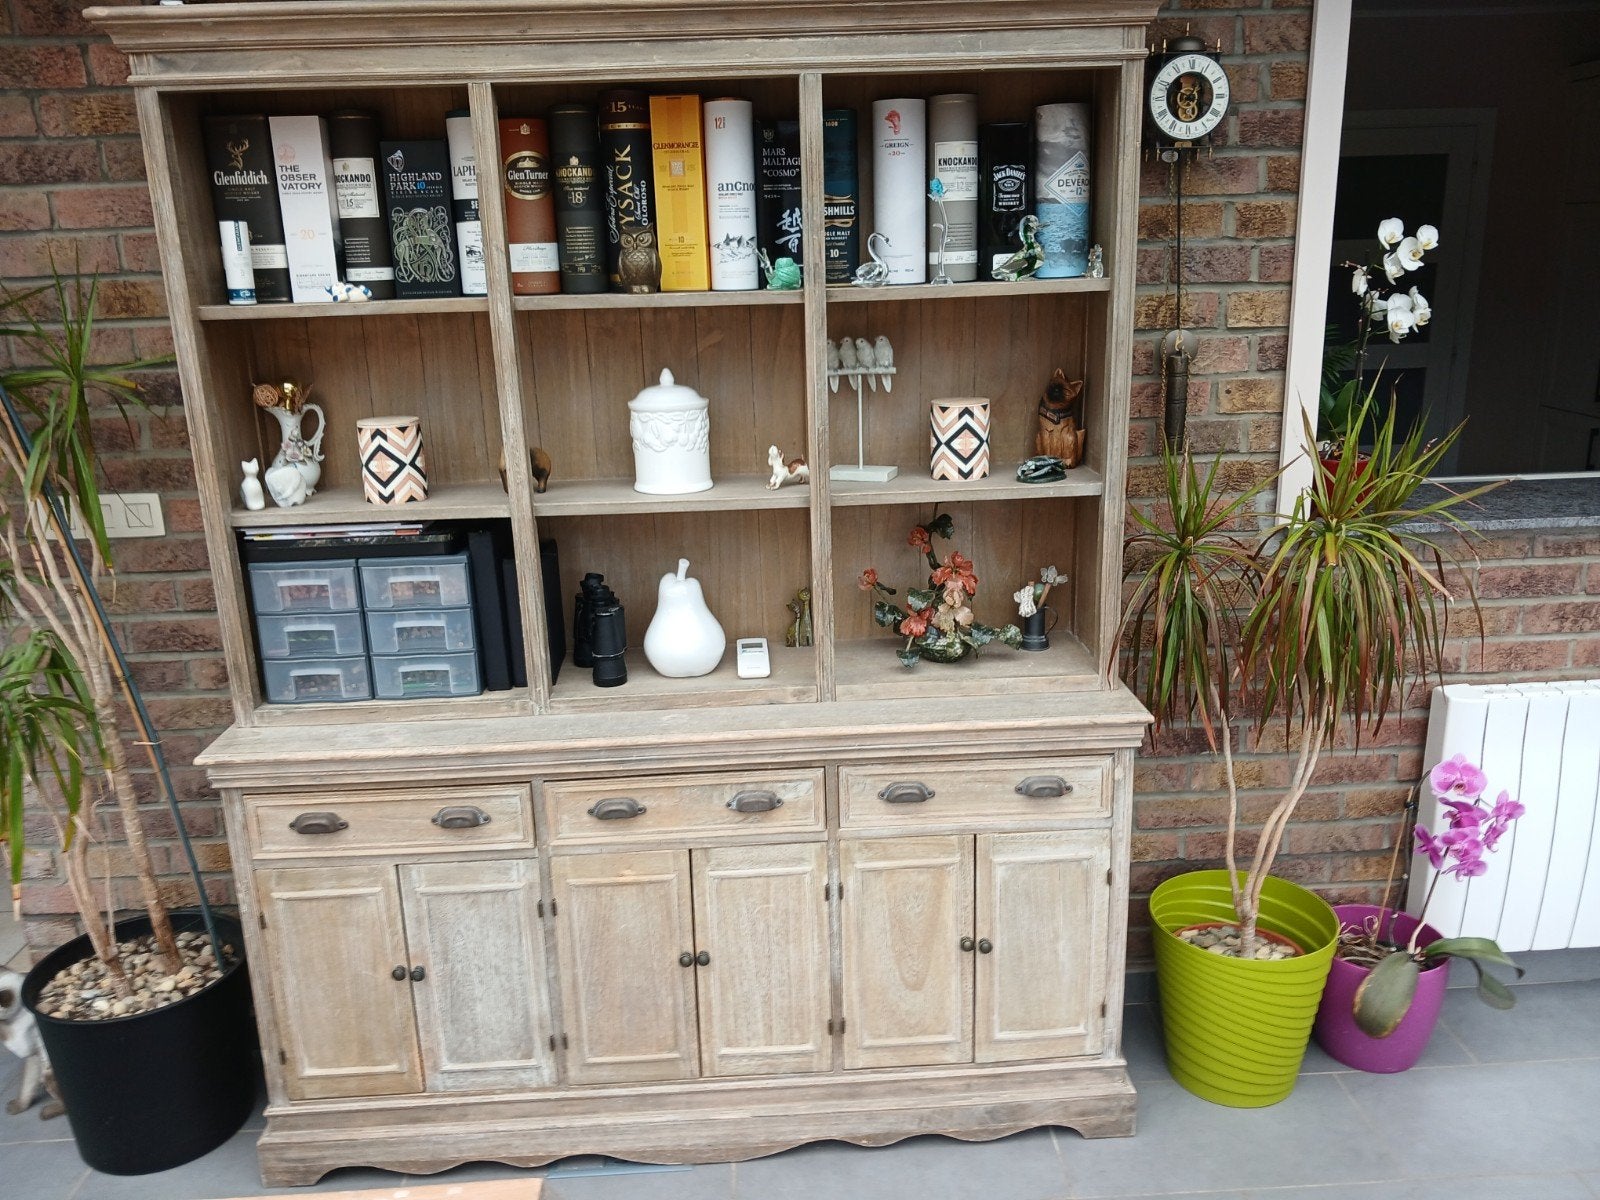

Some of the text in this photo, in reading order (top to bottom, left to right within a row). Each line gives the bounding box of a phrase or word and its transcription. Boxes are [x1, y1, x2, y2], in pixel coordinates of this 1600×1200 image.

[611, 101, 627, 113] 15
[714, 116, 722, 129] 12
[762, 147, 786, 156] MARS
[279, 165, 300, 173] THE
[213, 169, 269, 186] Glenfiddich
[280, 173, 317, 182] OBSER
[389, 172, 442, 182] HIGHLAND
[281, 182, 322, 191] VATORY
[390, 181, 417, 194] PARK
[718, 181, 756, 192] anCno
[571, 191, 583, 204] 18
[346, 198, 354, 208] 15
[640, 180, 649, 226] OLOROSO
[829, 249, 840, 258] 10
